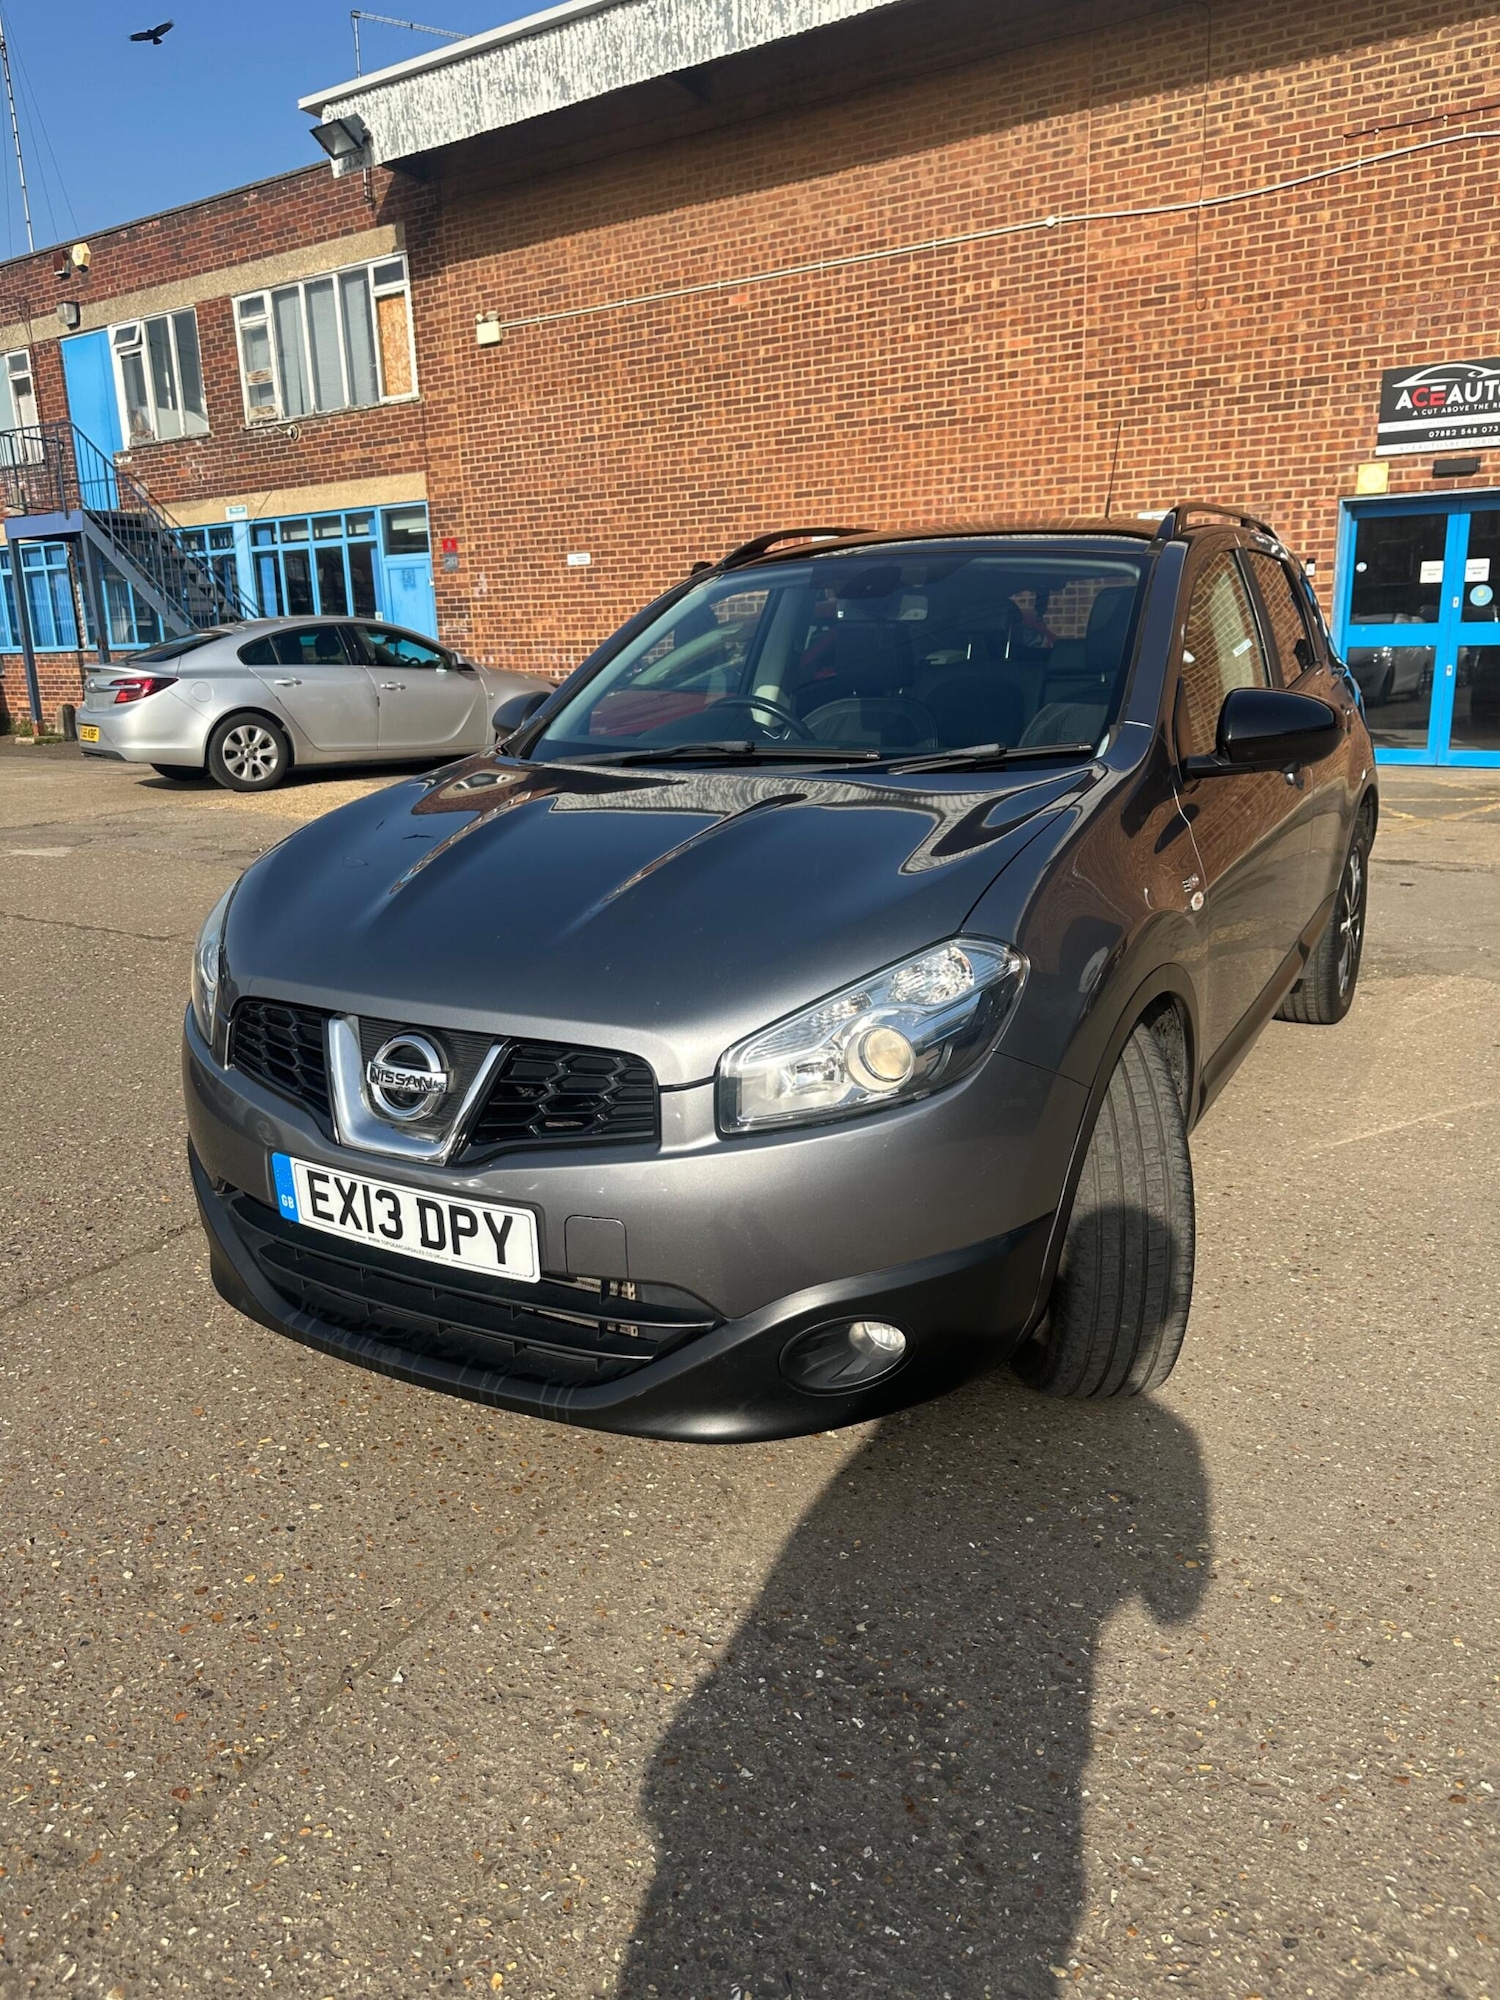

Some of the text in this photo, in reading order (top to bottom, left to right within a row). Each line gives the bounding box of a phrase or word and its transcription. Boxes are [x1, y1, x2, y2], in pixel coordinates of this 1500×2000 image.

[1395, 379, 1500, 410] ACEAUT
[1421, 407, 1438, 415] CUT
[1441, 404, 1470, 414] ABOVE
[1473, 402, 1489, 410] THE
[1481, 425, 1498, 433] 073
[369, 1067, 433, 1092] NISSAN
[281, 1194, 295, 1210] GB
[306, 1169, 513, 1265] EX13 DPY
